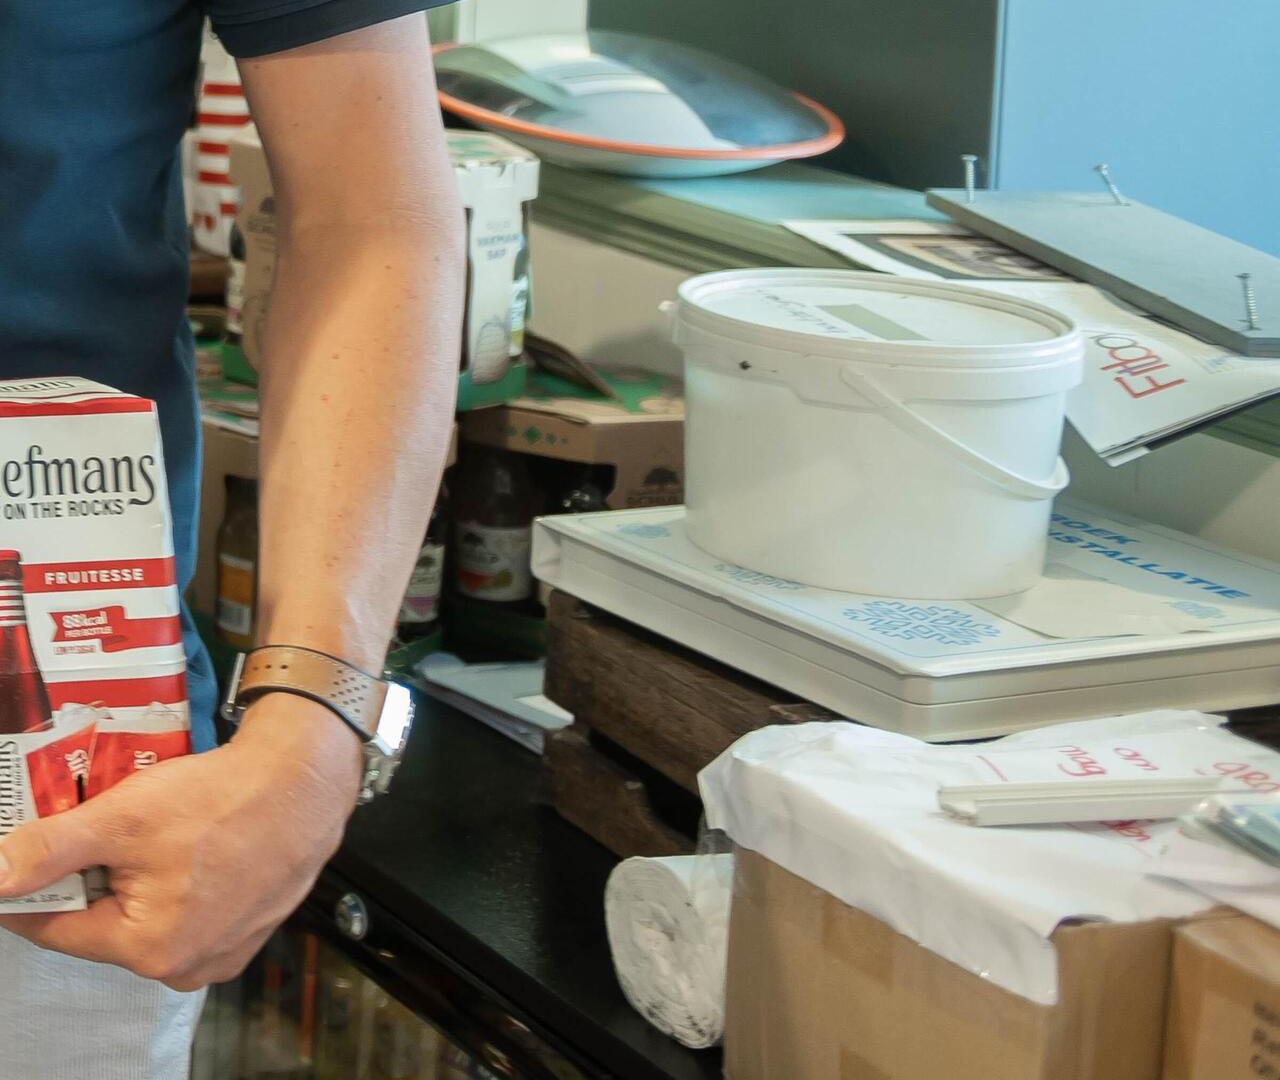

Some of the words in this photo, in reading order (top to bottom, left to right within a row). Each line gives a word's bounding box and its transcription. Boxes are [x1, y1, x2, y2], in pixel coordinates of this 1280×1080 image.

[3, 502, 27, 520] ON
[32, 500, 62, 519] THE
[67, 498, 125, 518] ROCKS
[44, 568, 144, 585] FRUITESSE
